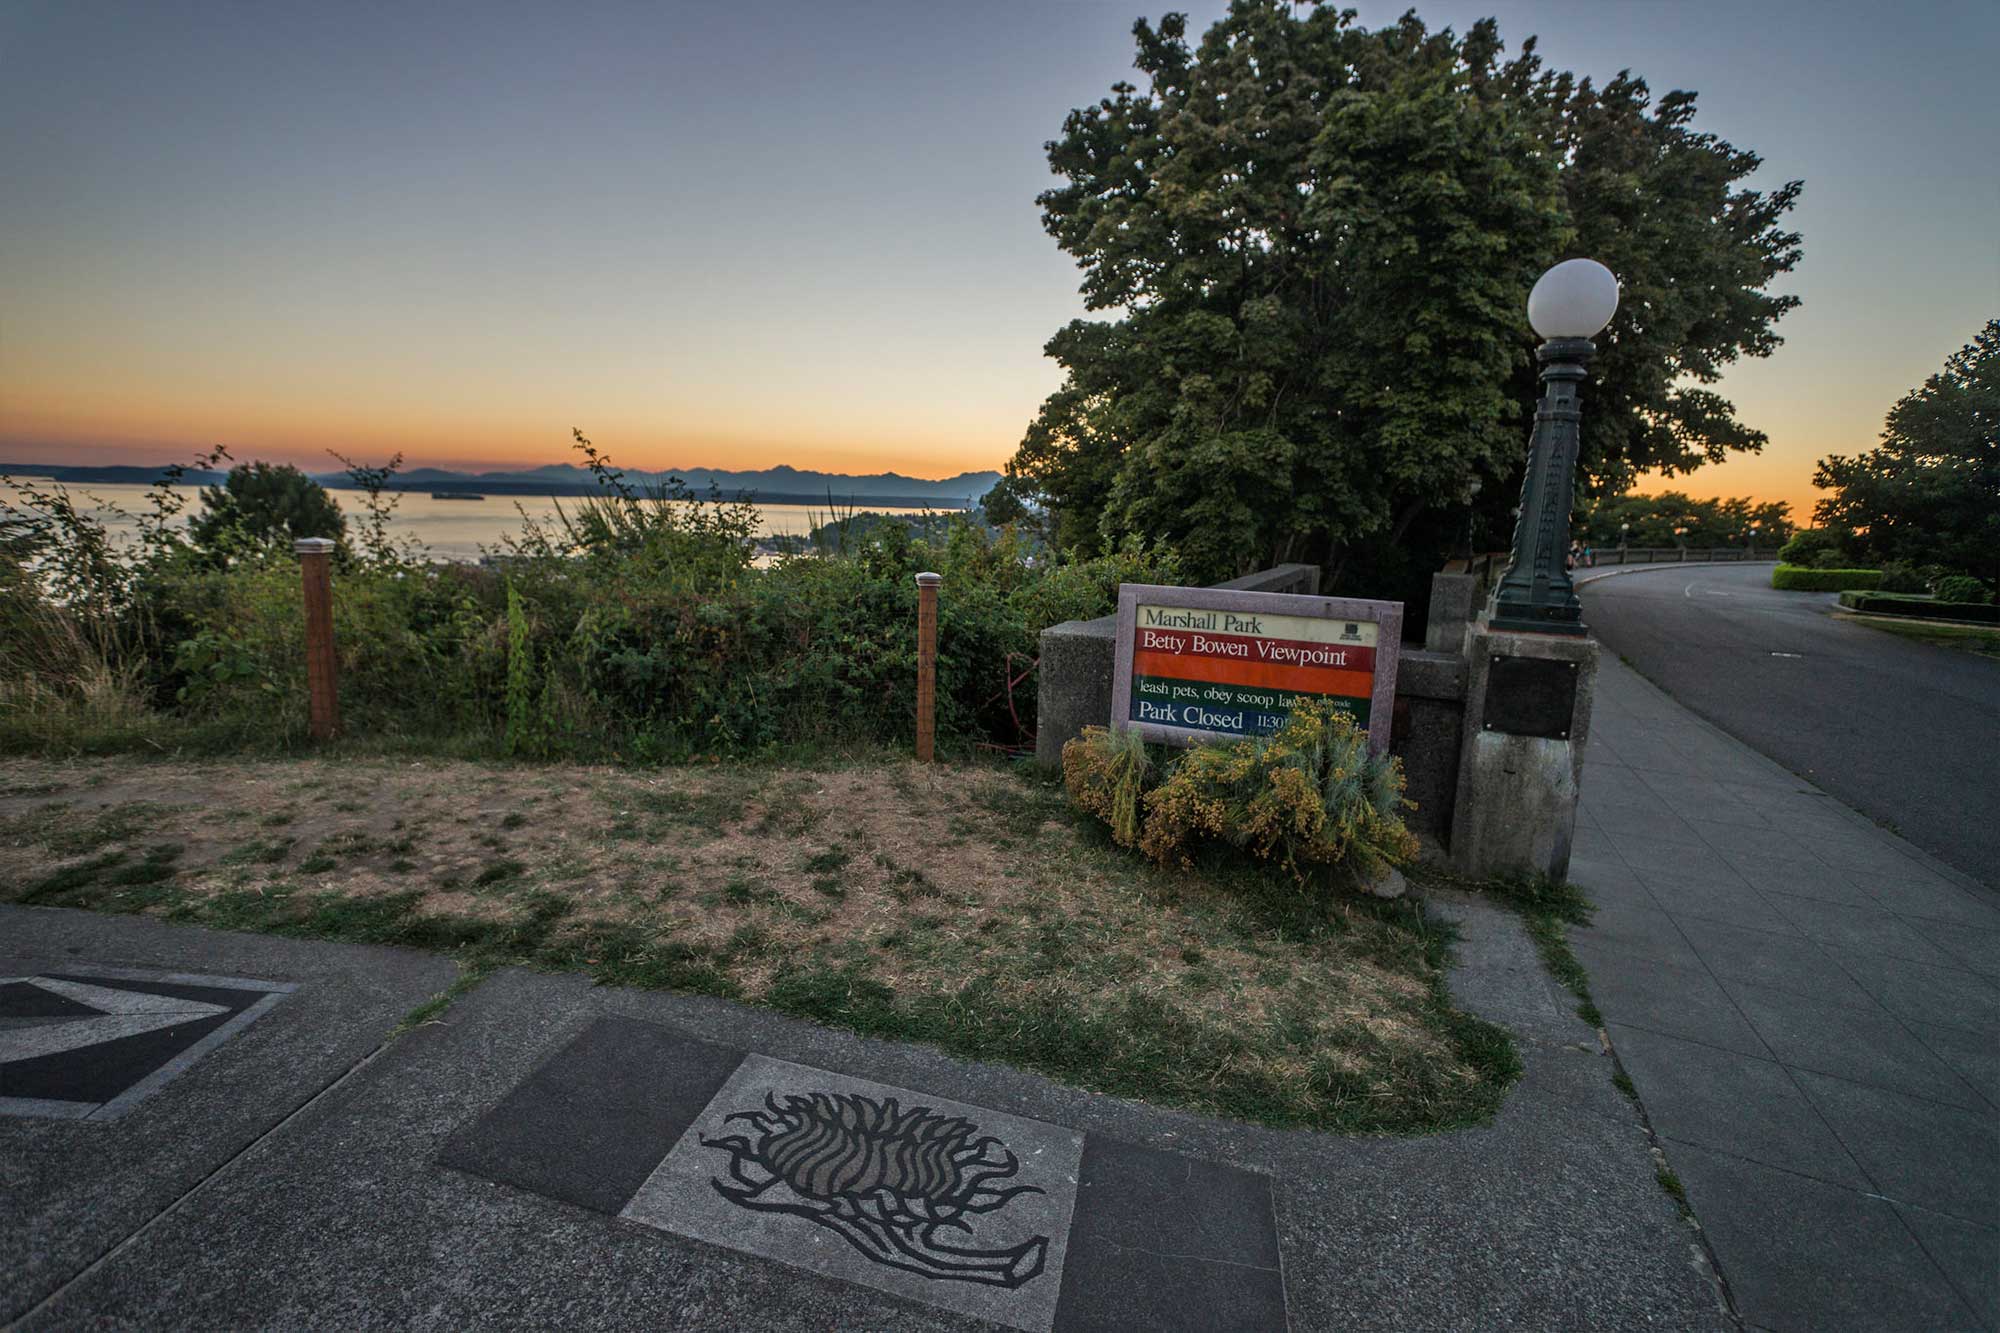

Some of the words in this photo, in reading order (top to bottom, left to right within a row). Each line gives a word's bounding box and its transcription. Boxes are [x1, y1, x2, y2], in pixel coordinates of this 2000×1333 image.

[1145, 608, 1217, 631] Marshall
[1224, 614, 1262, 634] Park
[1143, 631, 1187, 655] Betty
[1192, 635, 1249, 657] Bowen
[1256, 640, 1348, 667] Viewpoint
[1140, 679, 1169, 695] leash
[1172, 685, 1200, 699] pets,
[1203, 687, 1232, 704] obey
[1236, 692, 1274, 709] scoop
[1138, 701, 1177, 722] Park
[1183, 706, 1243, 729] Closed
[1257, 714, 1284, 728] 11:30
